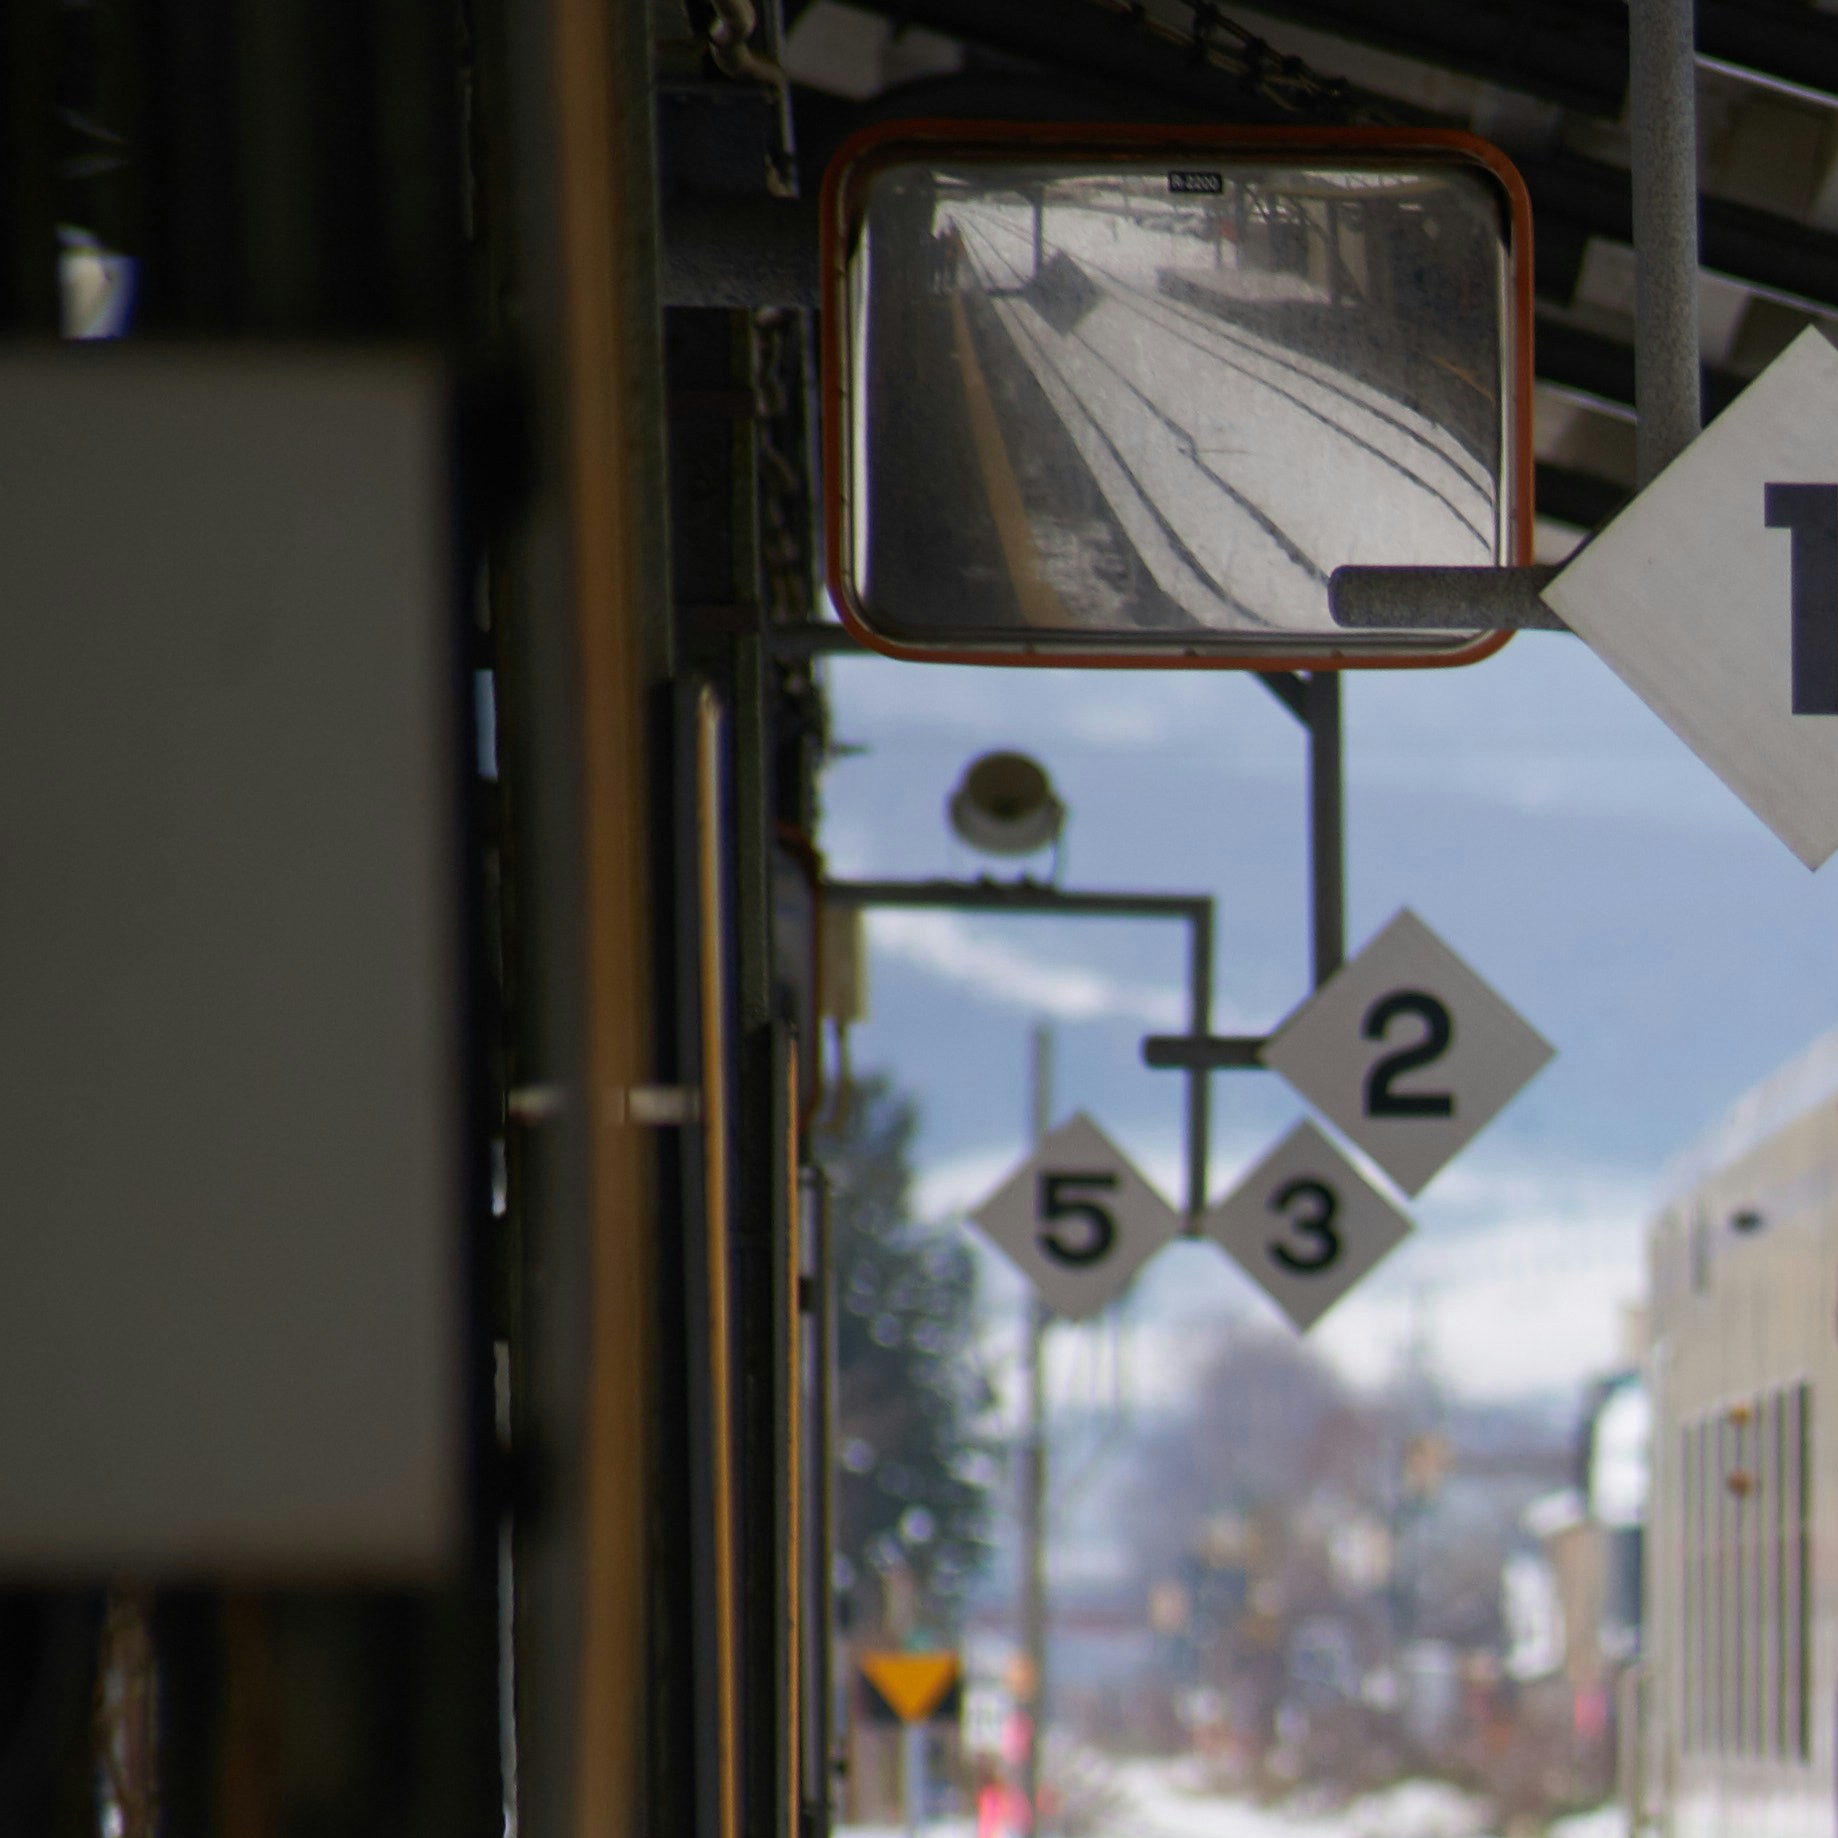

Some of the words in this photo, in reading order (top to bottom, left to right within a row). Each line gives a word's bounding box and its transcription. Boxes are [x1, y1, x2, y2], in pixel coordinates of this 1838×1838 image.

[1764, 482, 1838, 715] 1
[1361, 988, 1454, 1118] 2
[1035, 1171, 1118, 1269] 5
[1267, 1176, 1343, 1275] 3
